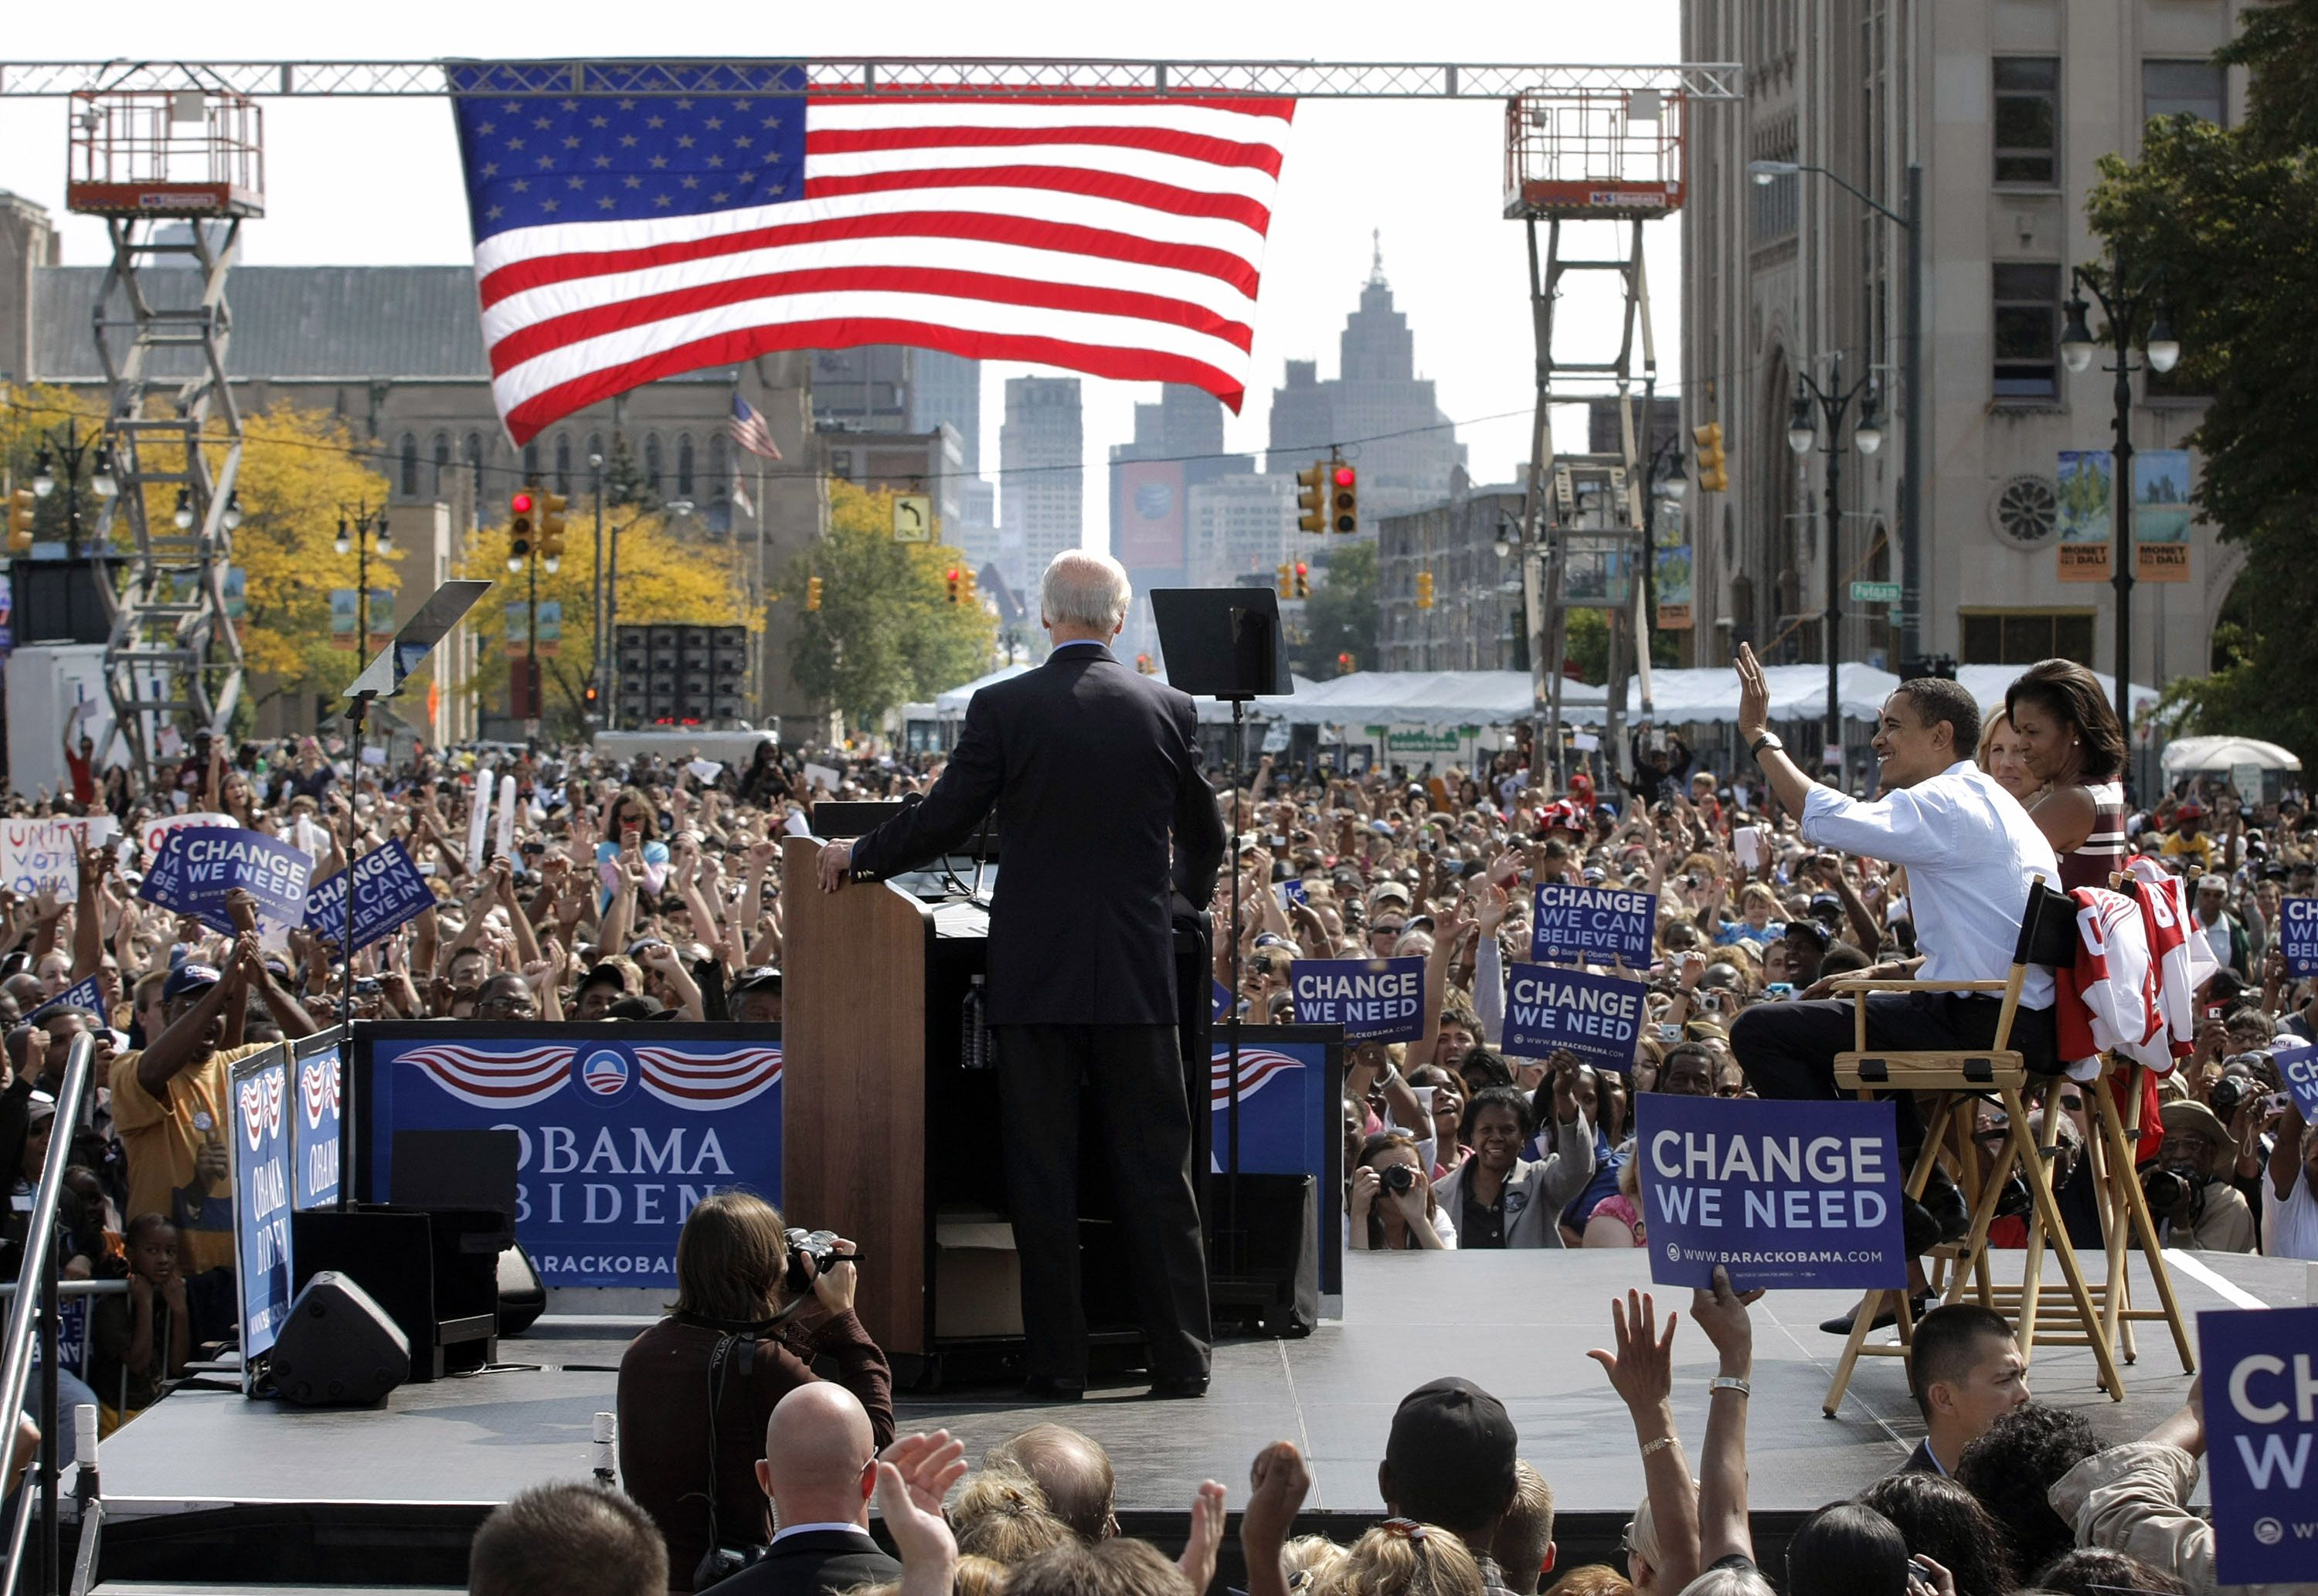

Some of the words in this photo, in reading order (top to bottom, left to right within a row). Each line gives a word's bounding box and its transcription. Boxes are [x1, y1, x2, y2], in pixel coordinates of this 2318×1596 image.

[897, 529, 926, 538] ONLY
[2061, 546, 2107, 555] MONET
[2140, 546, 2186, 555] MONET
[187, 840, 307, 886] CHANGE
[187, 862, 226, 884] WE
[234, 864, 302, 901] NEED
[305, 844, 402, 914] CHANGE
[359, 862, 413, 904] CAN
[397, 879, 421, 901] IN
[1541, 887, 1647, 915] CHANGE
[1540, 908, 1583, 928] WE
[1591, 911, 1646, 936] CAN
[2288, 922, 2318, 941] W
[1538, 928, 1619, 949] BELIEVE
[1623, 936, 1644, 952] IN
[1297, 972, 1418, 1000] CHANGE
[1514, 979, 1637, 1020] CHANGE
[1300, 1002, 1336, 1021] WE
[1345, 997, 1418, 1022] NEED
[1513, 1004, 1557, 1029] WE
[1566, 1011, 1632, 1041] NEED
[1354, 1025, 1413, 1039] CKOBAMA.COM
[1527, 1037, 1624, 1058] WWW.BARACKOBAMA.COM
[1651, 1129, 1886, 1183] CHANGE
[253, 1156, 286, 1222] OBAMA
[1655, 1183, 1722, 1228] WE
[1745, 1189, 1887, 1228] NEED
[257, 1217, 288, 1275] BIDEN
[1684, 1248, 1883, 1263] WWW.BARACKOBAMA.COM
